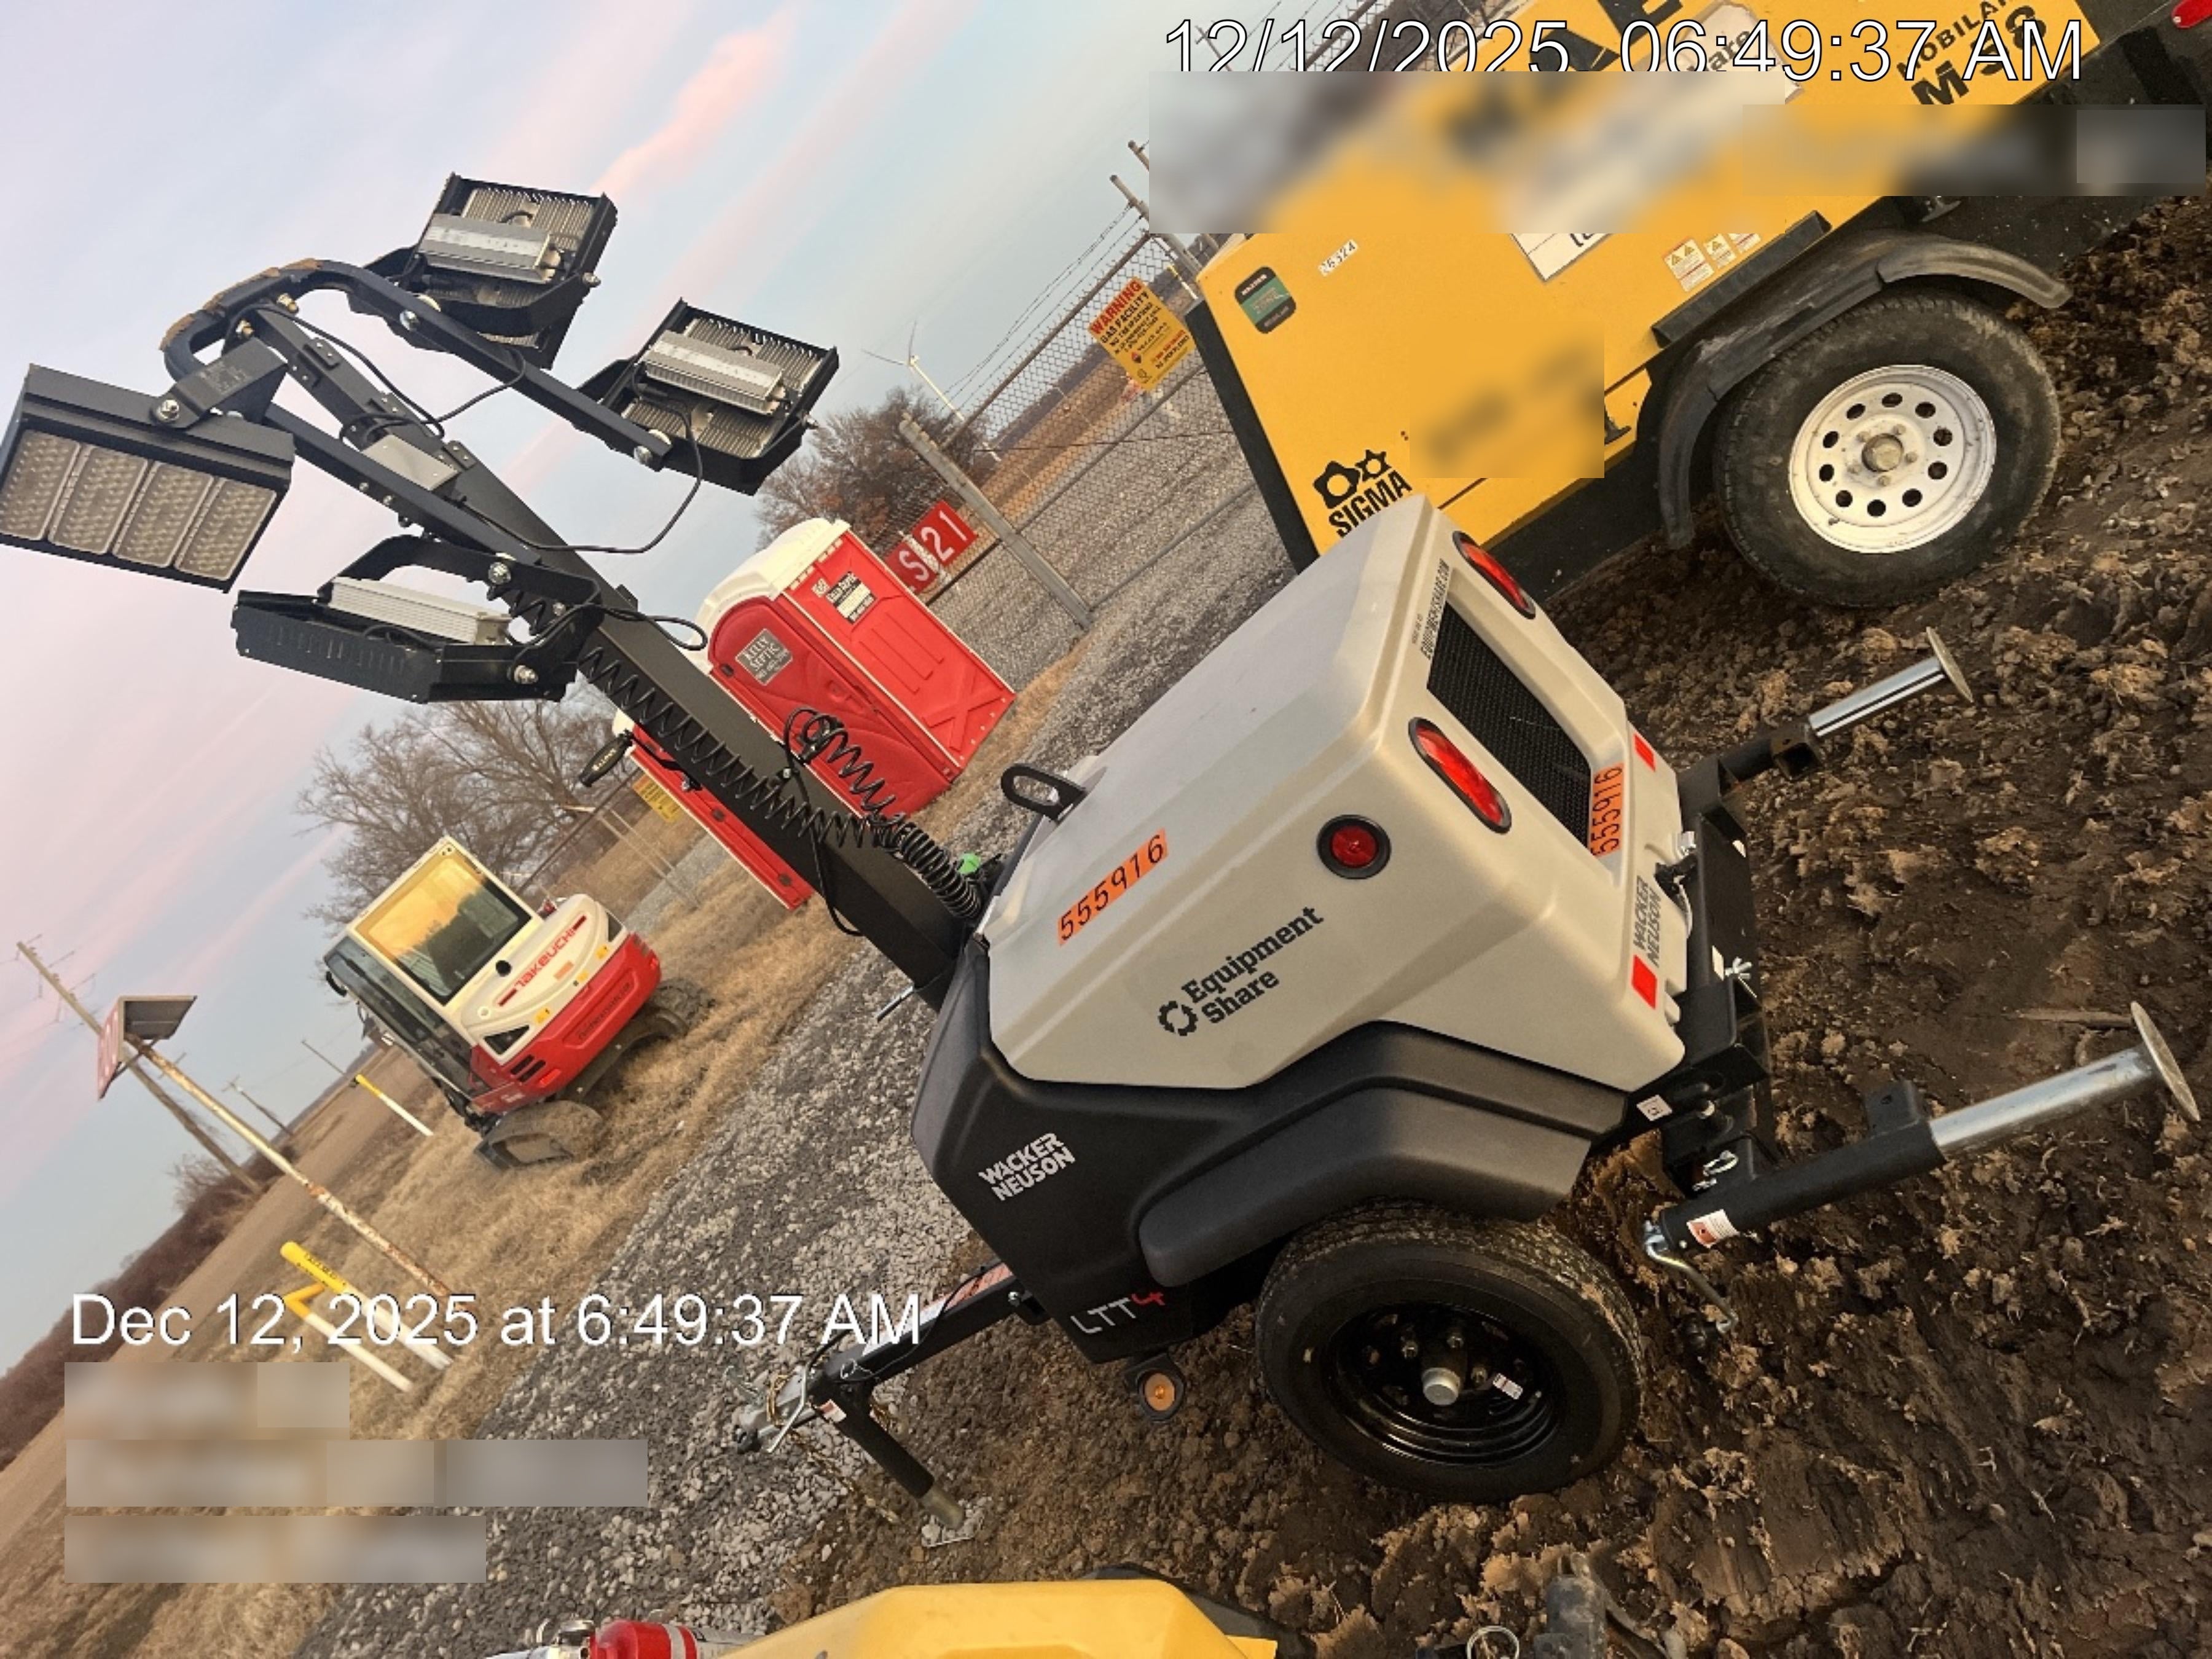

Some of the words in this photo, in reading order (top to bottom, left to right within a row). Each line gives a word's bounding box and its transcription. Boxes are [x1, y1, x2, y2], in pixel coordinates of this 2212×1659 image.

[1897, 0, 2006, 80] MOBILA
[1091, 281, 1142, 334] WARNING
[1115, 291, 1148, 327] FACILITY
[1328, 470, 1412, 538] SIGMA
[899, 549, 930, 581] S
[920, 510, 968, 562] 21
[742, 636, 769, 661] KELLY
[750, 643, 780, 671] SEPTIC
[1591, 767, 1622, 855] 555916
[1060, 834, 1164, 941] 555916
[1633, 875, 1649, 950] WACKER
[515, 927, 578, 989] TAKEUCHI
[1180, 906, 1324, 1003] Equipment
[1647, 886, 1661, 968] NEUSON
[1201, 970, 1280, 1024] Share
[978, 1132, 1064, 1185] WACKER
[990, 1146, 1075, 1201] NEUSON
